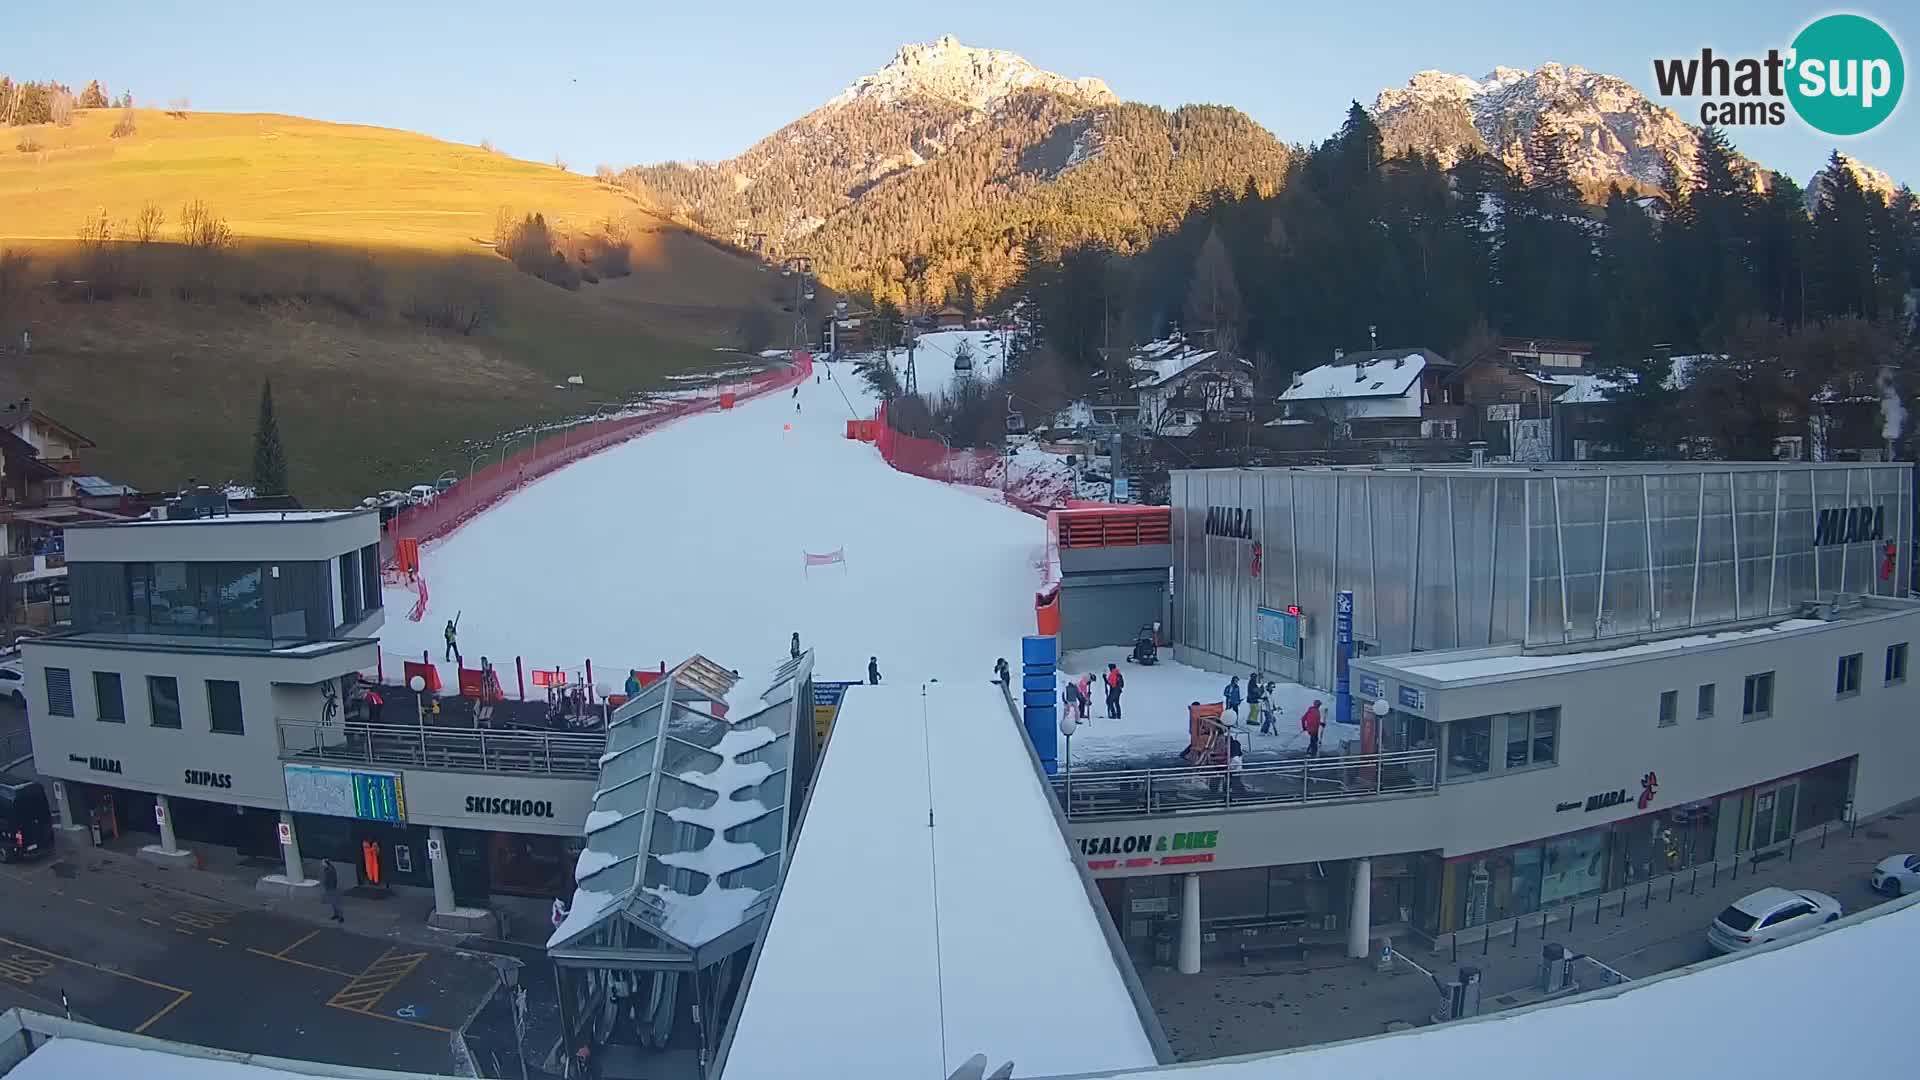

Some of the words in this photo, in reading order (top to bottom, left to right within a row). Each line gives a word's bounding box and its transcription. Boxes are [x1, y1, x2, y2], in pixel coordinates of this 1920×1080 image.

[1205, 506, 1252, 540] MIARA
[1814, 505, 1884, 546] MIARA
[90, 757, 122, 775] MIARA
[184, 768, 233, 789] SKIPASS
[464, 795, 554, 818] SKISCHOOL
[1584, 788, 1626, 813] MIARA
[1078, 835, 1152, 856] ISALON
[1156, 836, 1168, 852] &
[1172, 830, 1219, 851] BIKE
